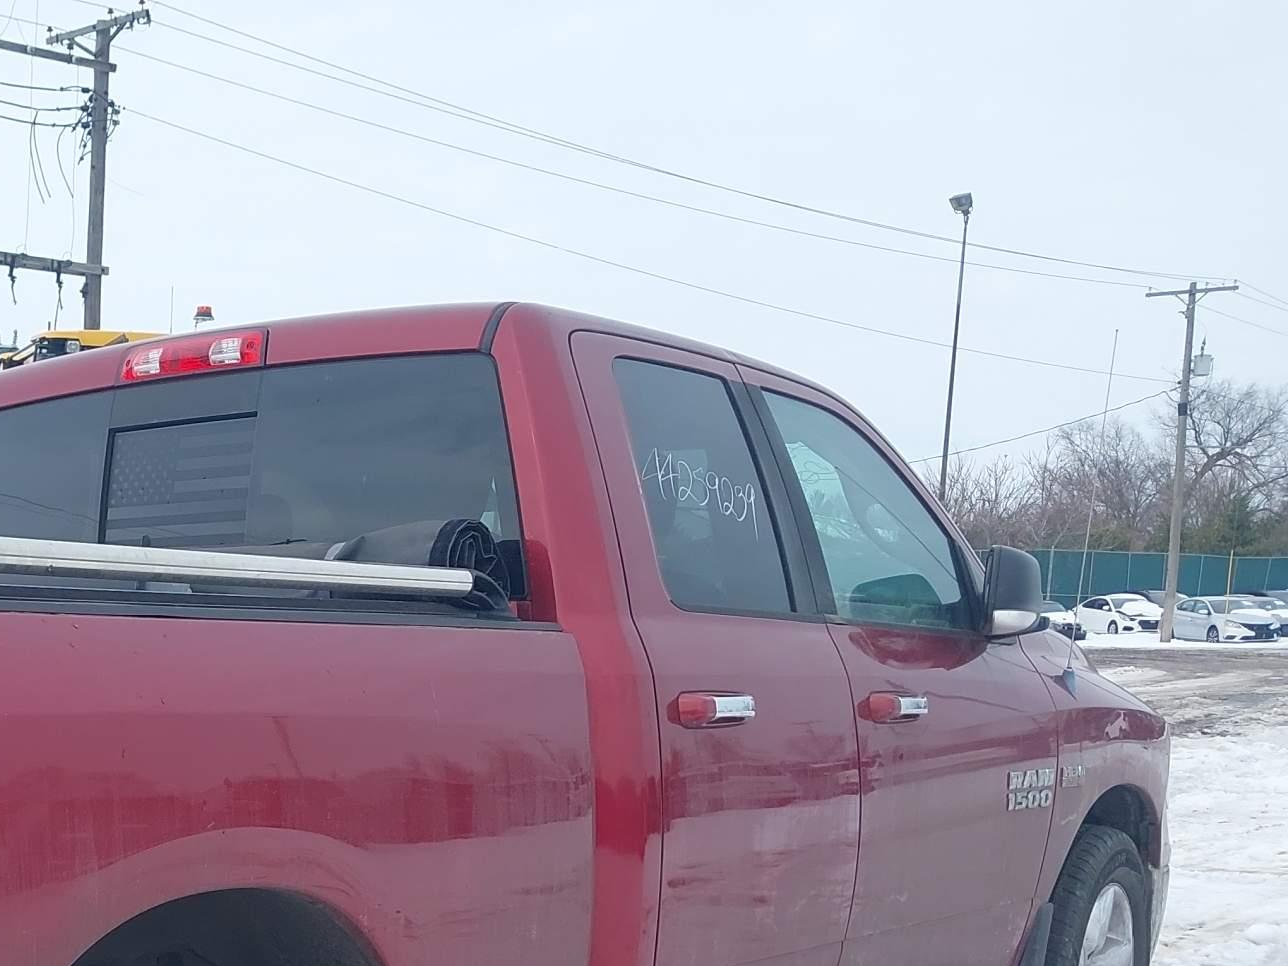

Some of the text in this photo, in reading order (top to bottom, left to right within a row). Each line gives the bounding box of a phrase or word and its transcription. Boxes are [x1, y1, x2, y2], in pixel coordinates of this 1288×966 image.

[642, 448, 758, 540] 44259239
[1008, 768, 1055, 790] RAM
[1007, 789, 1052, 812] 1500
